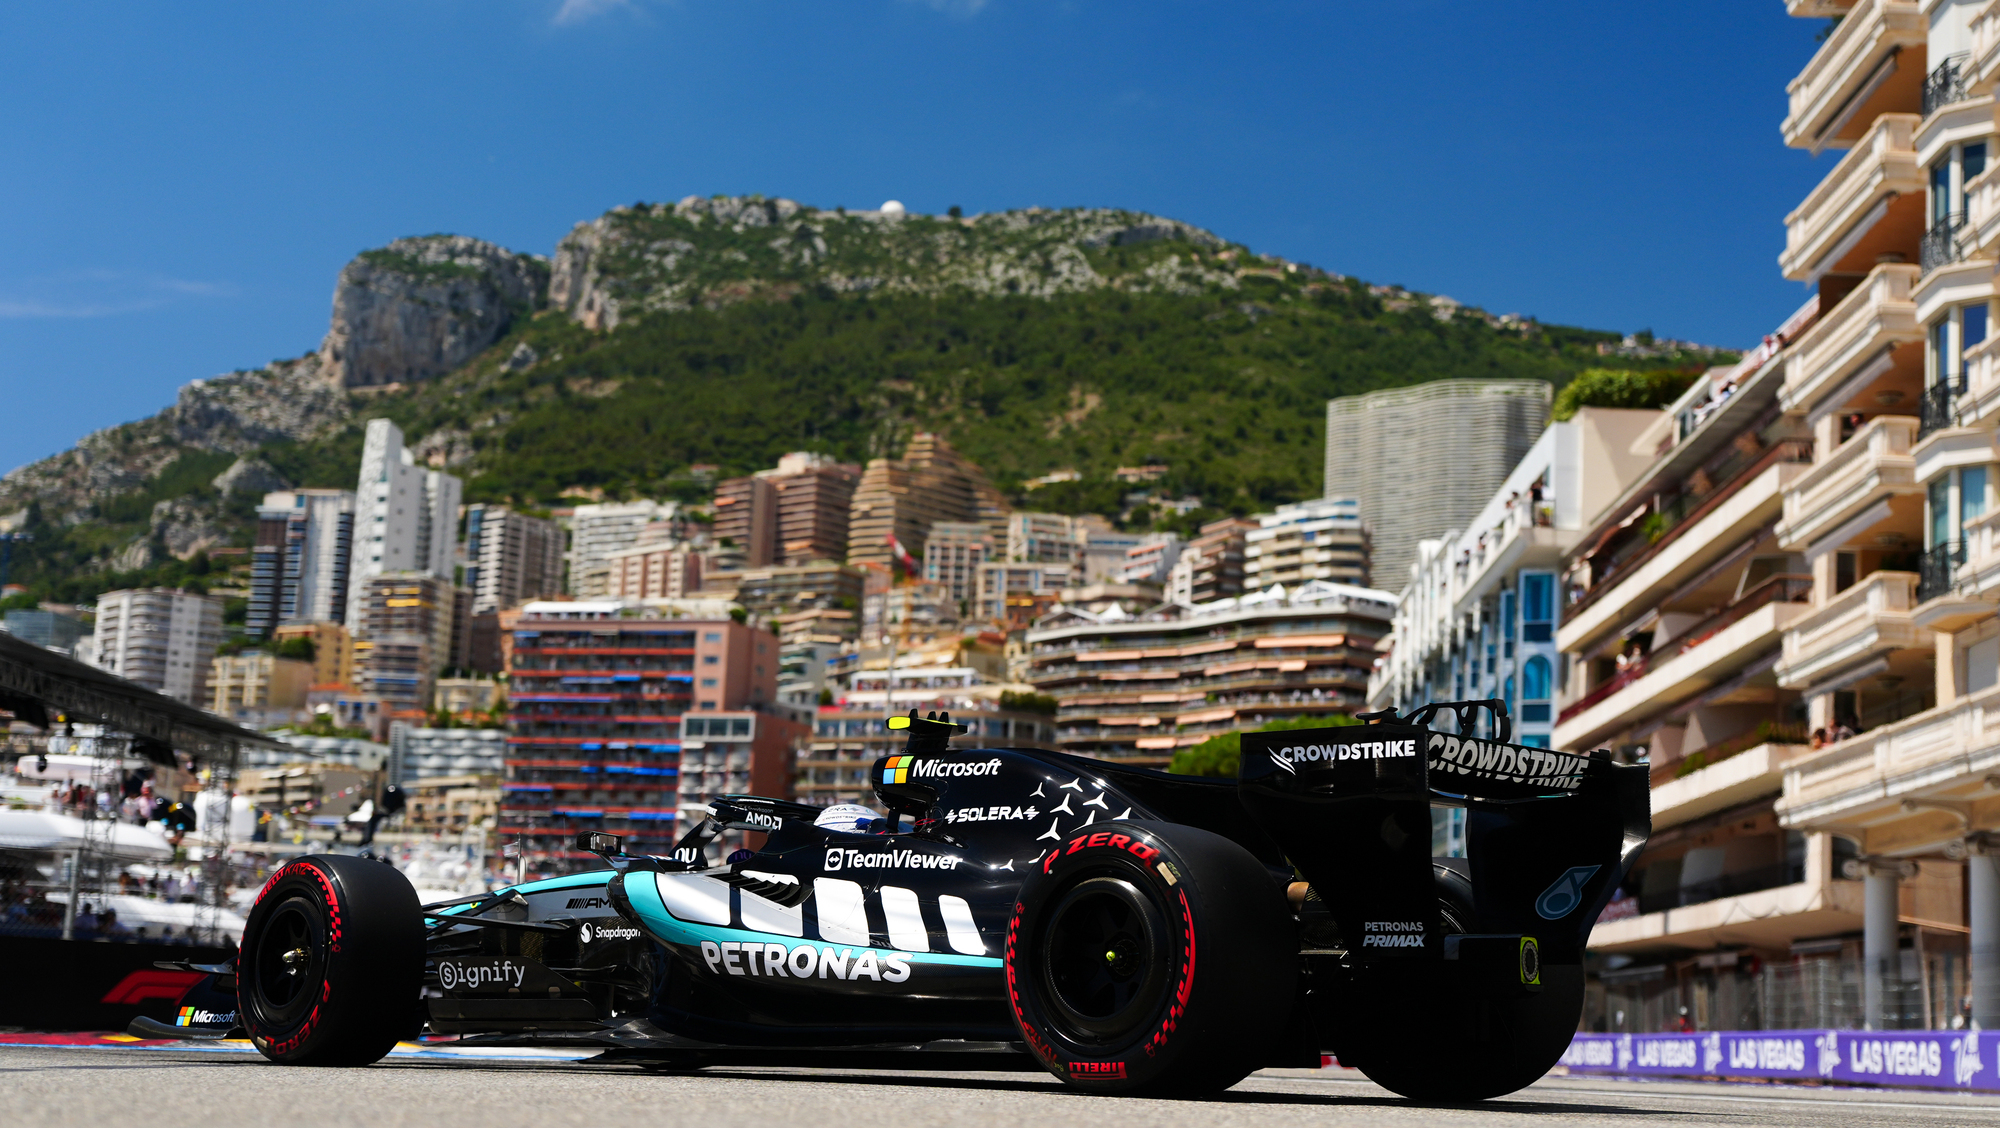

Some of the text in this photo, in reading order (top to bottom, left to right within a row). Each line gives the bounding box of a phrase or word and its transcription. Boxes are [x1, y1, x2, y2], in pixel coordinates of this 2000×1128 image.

[1280, 739, 1416, 763] CROWDSTRIKE
[1429, 733, 1590, 789] CROWDSTRIKE
[912, 758, 1002, 778] Microsoft
[745, 811, 772, 827] AMD
[956, 806, 1024, 823] SOLERA
[845, 849, 963, 870] TeamViewer
[1043, 832, 1156, 875] P ZERO
[585, 897, 616, 909] AM
[1364, 921, 1424, 932] PETRONAS
[1362, 932, 1428, 947] PRIMAX
[700, 940, 915, 983] PETRONAS
[439, 961, 525, 990] signify
[192, 1009, 236, 1023] Microsoft
[275, 1004, 321, 1055] ZERO
[1729, 1038, 1757, 1069] LAS
[1757, 1038, 1805, 1071] VEGAS
[1850, 1039, 1883, 1074] LAS
[1883, 1040, 1941, 1077] VEGAS
[1069, 1061, 1127, 1081] PIRELLI
